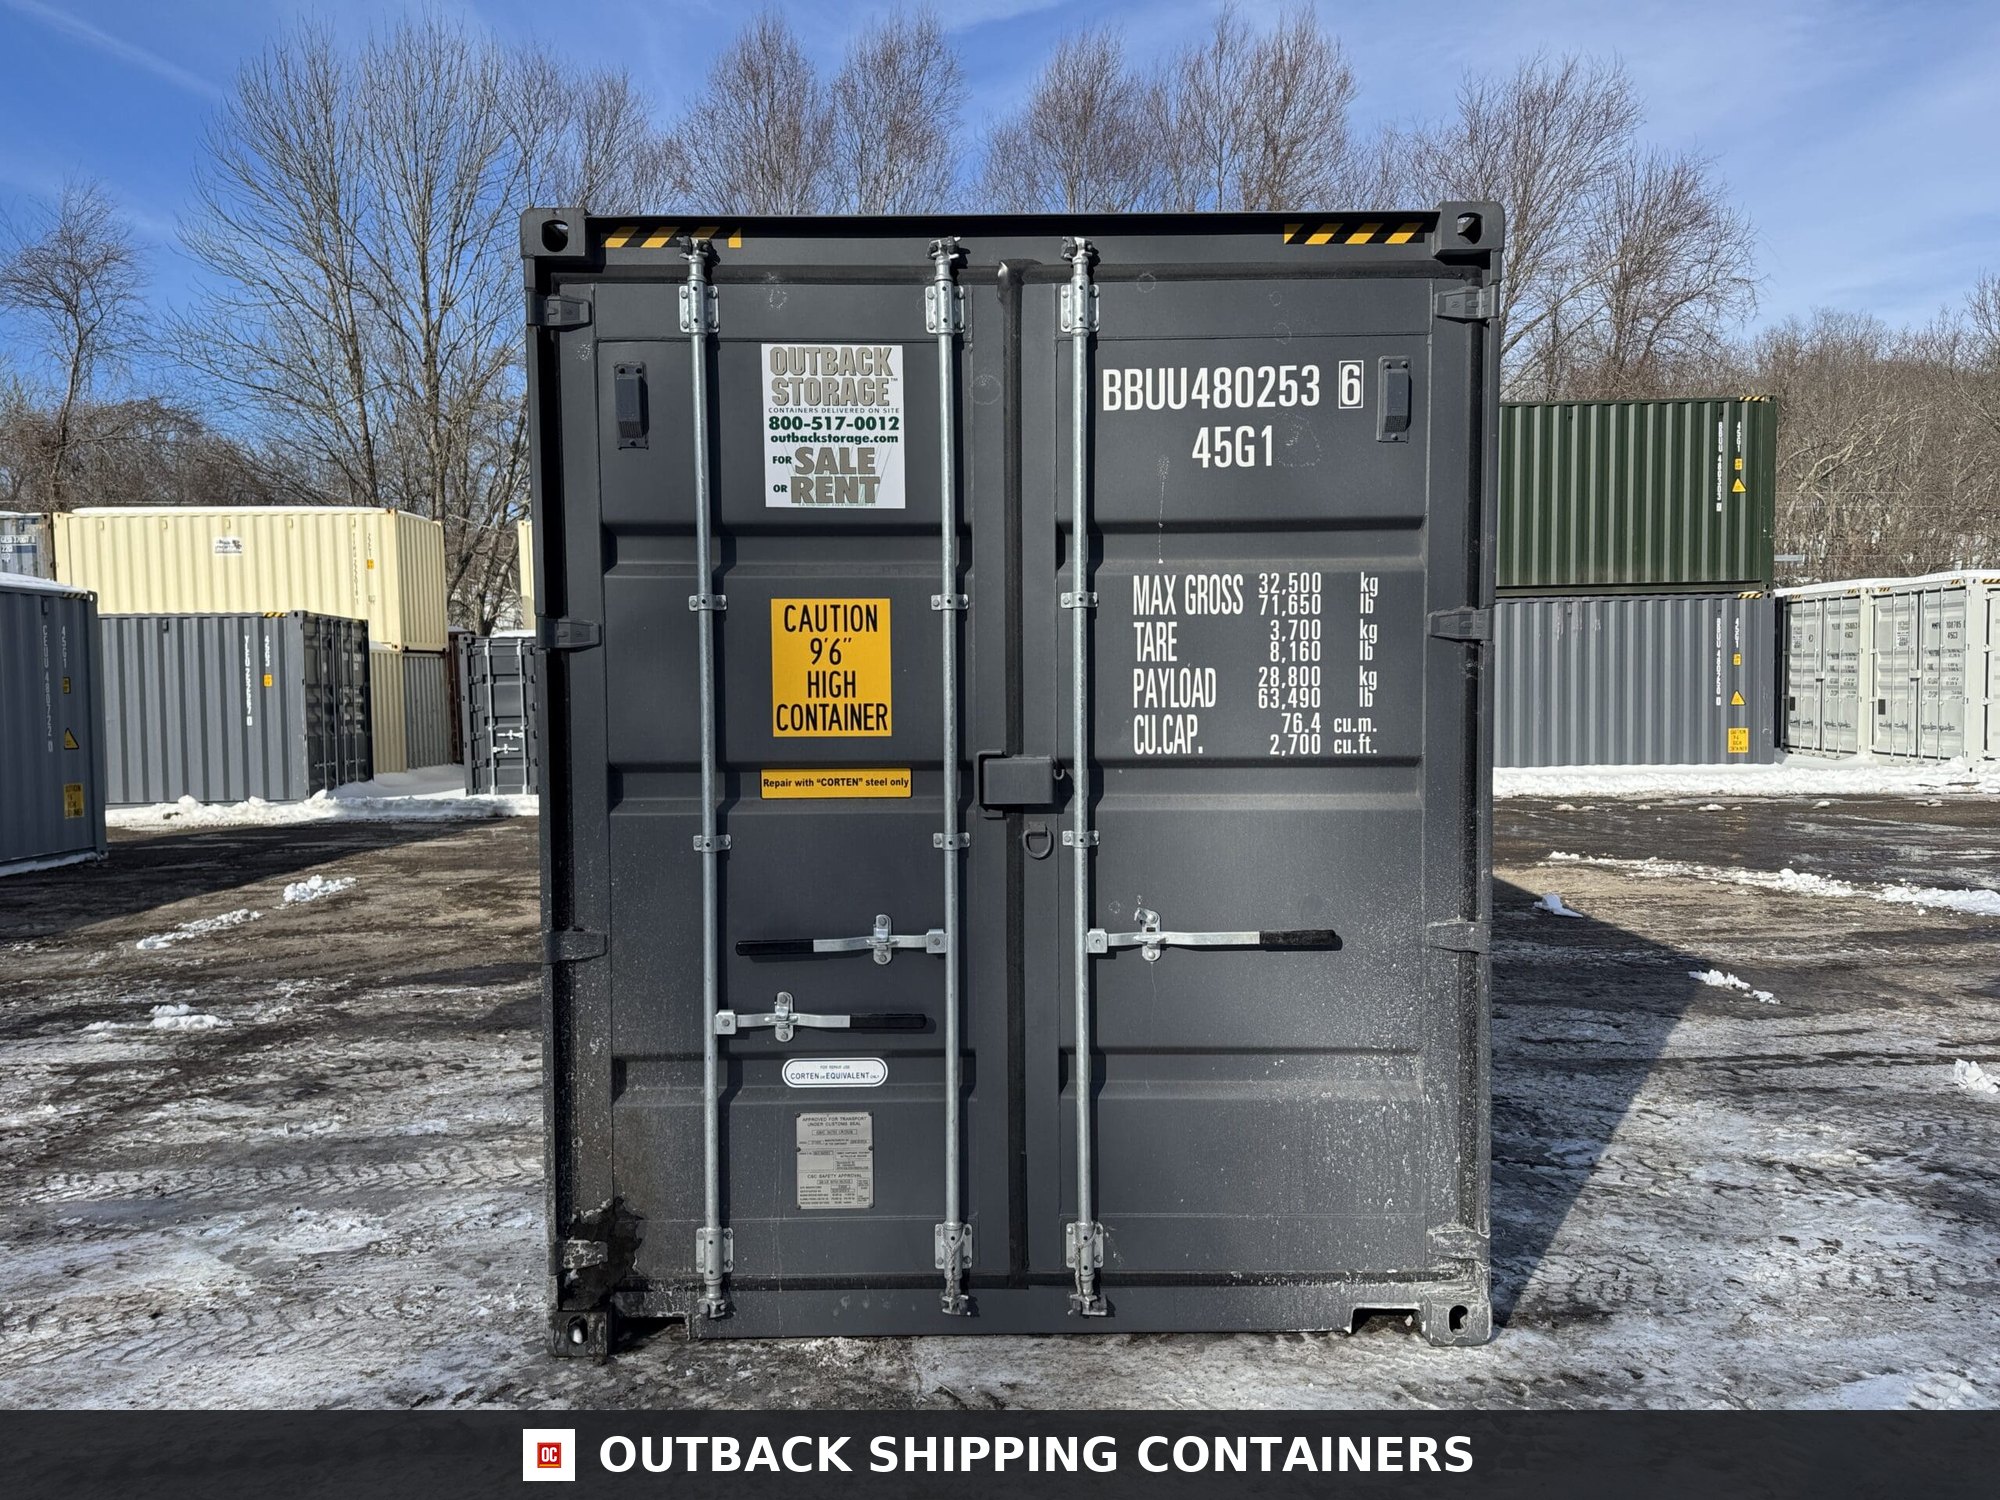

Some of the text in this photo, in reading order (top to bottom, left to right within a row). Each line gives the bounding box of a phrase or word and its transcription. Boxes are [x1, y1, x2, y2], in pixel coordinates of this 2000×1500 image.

[769, 346, 893, 376] OUTBACK
[771, 377, 890, 406] STORAGE
[1341, 363, 1360, 407] 6
[768, 416, 900, 431] 800-517-0012
[770, 432, 898, 445] outbackstorage.com
[1191, 424, 1273, 469] 45G1
[772, 446, 876, 475] FOR SALE
[773, 476, 881, 504] OR RENT
[1132, 571, 1378, 616] MAX GROSS 32,500 kg
[1258, 592, 1374, 617] 71,650 lb
[783, 604, 878, 633] CAUTION
[1133, 618, 1378, 662] TARE 3,700 kg
[1270, 640, 1373, 663] 8,160 lb
[807, 670, 856, 698] HIGH
[1133, 665, 1378, 709] PAYLOAD 28,800 kg
[1258, 686, 1373, 710] 63,490 lb
[776, 703, 888, 731] CONTAINER
[1133, 712, 1378, 755] CU.CAP. 76.4 cu.m.
[1269, 734, 1378, 757] 2,700 cu.ft.
[763, 778, 792, 789] Repair
[794, 778, 814, 787] with
[865, 777, 888, 786] steel
[890, 778, 909, 788] only
[790, 1072, 820, 1080] CORTEN
[825, 1072, 870, 1080] EQUIVALENT
